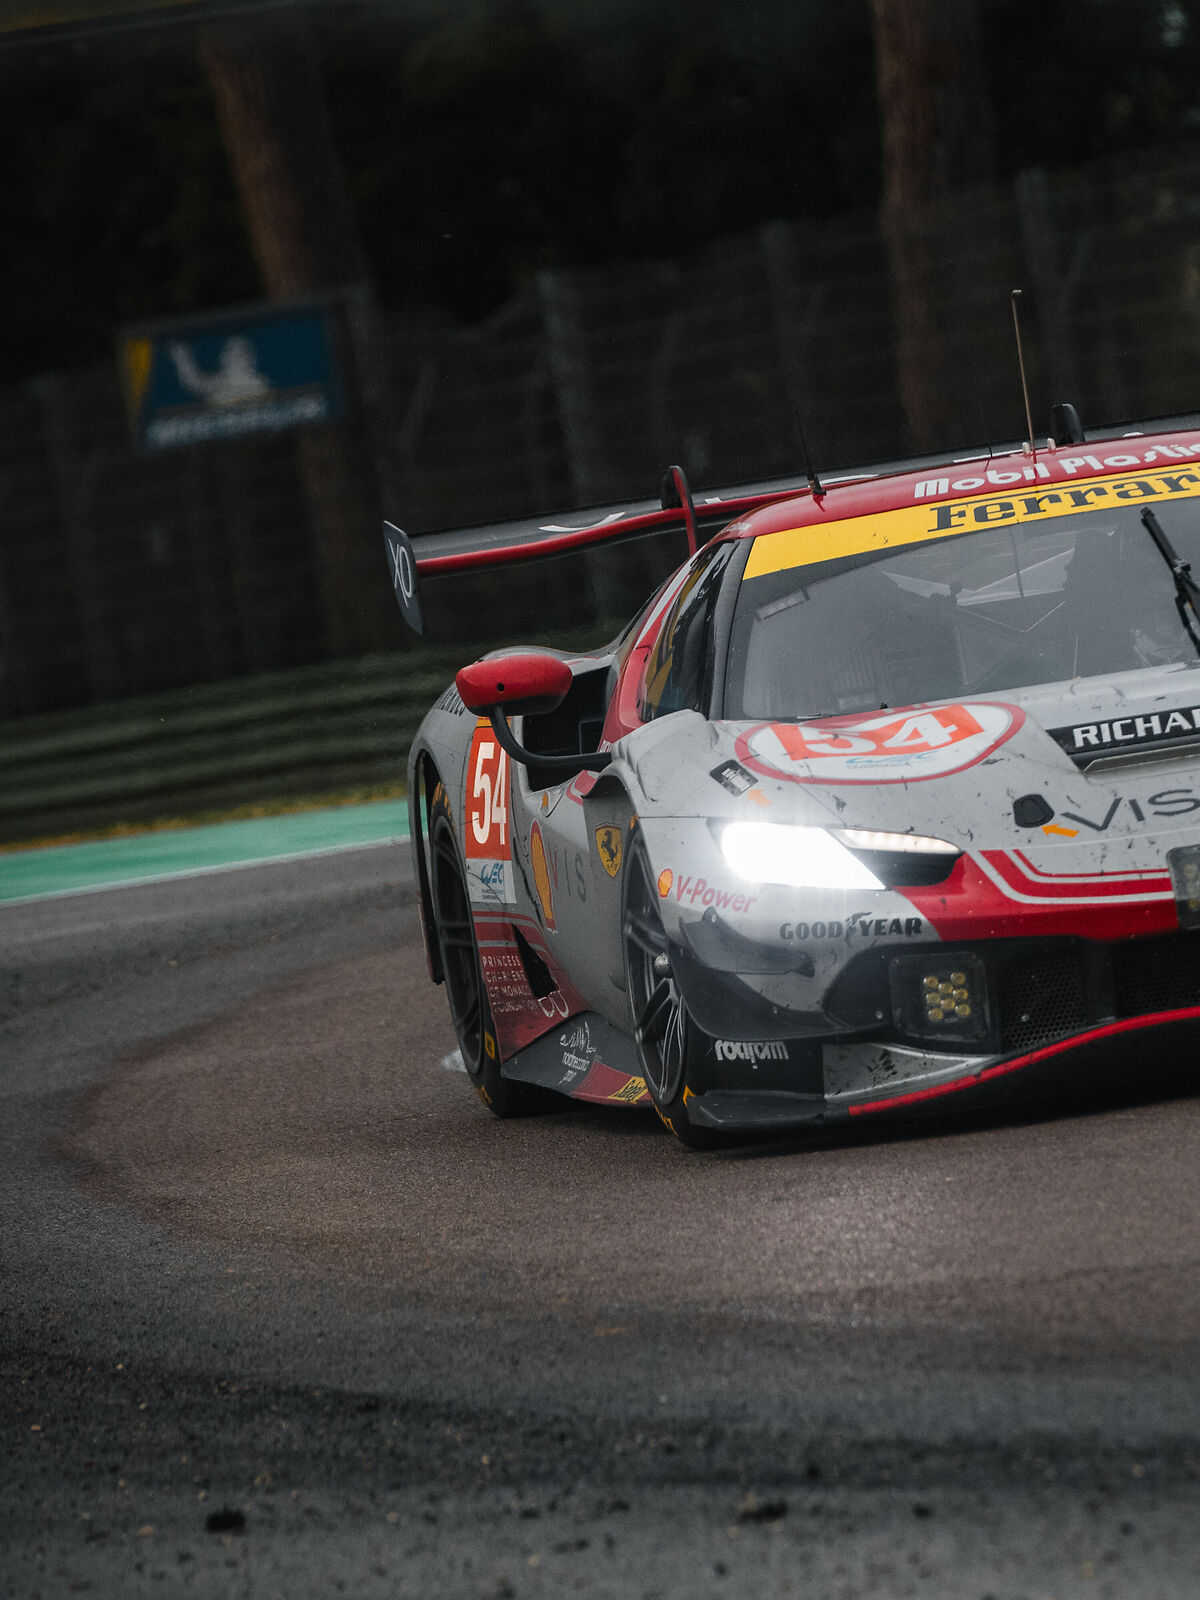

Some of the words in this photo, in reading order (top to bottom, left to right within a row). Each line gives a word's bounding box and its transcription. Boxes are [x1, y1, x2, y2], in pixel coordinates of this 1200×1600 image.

[913, 462, 1050, 498] Mobil
[797, 712, 958, 755] 54
[472, 742, 508, 846] 54
[675, 874, 758, 914] V-Power
[779, 912, 923, 943] GOODYEAR
[482, 954, 521, 968] PRINCESS
